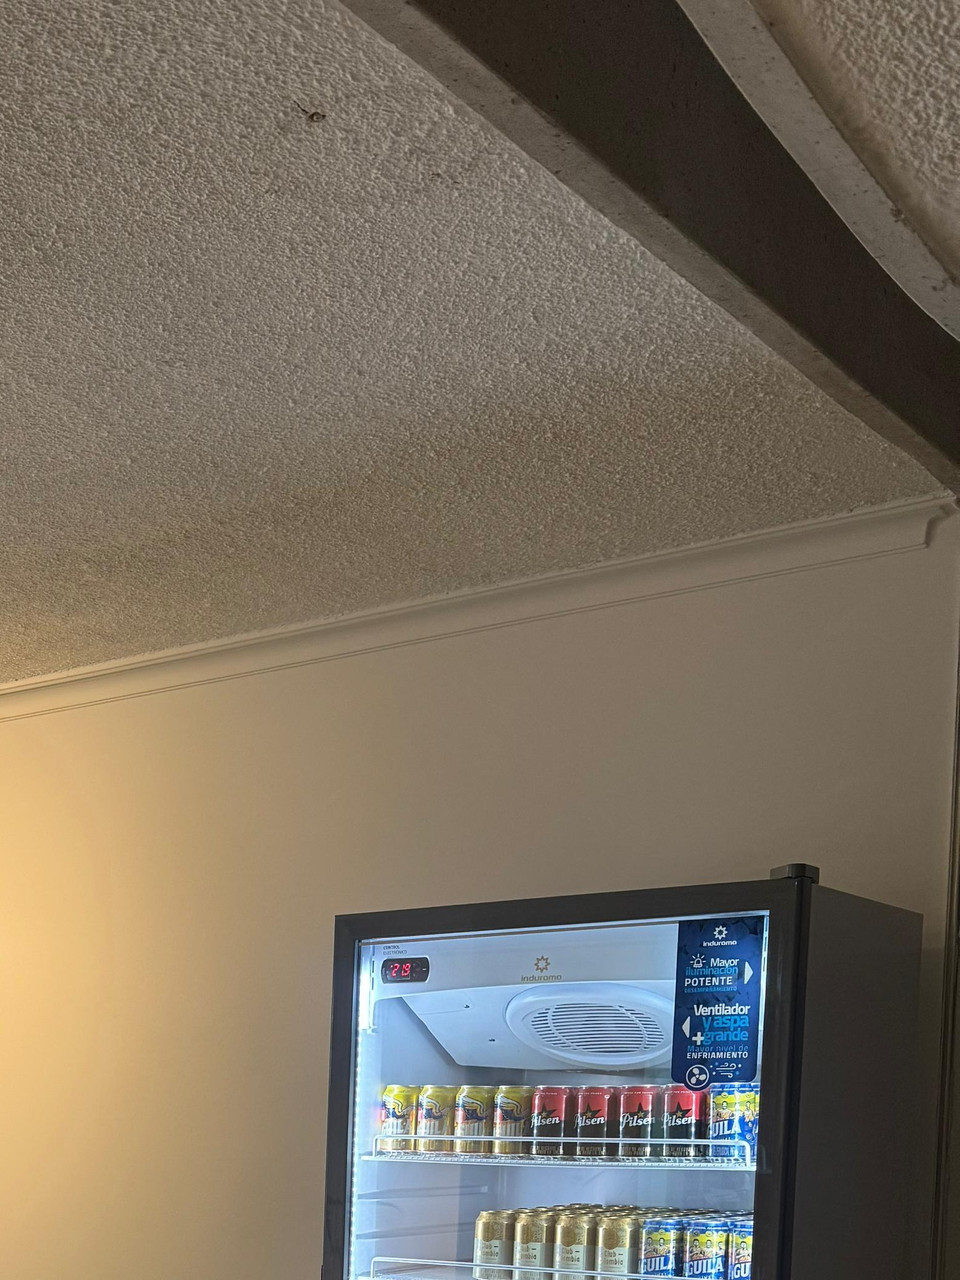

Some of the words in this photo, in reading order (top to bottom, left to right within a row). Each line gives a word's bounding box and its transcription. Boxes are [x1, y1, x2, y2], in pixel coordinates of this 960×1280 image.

[710, 958, 739, 968] Mayor
[684, 976, 733, 987] POTENTE
[693, 1003, 751, 1016] Ventilador
[702, 1017, 711, 1031] y
[713, 1015, 749, 1031] aspa
[715, 1044, 736, 1052] nivel
[738, 1043, 749, 1052] de
[686, 1051, 749, 1060] ENFRIAMIENTO
[530, 1113, 561, 1129] Pilsen
[574, 1113, 606, 1129] Pilsen
[621, 1113, 655, 1129] Pilsen
[661, 1113, 697, 1129] Pilsen
